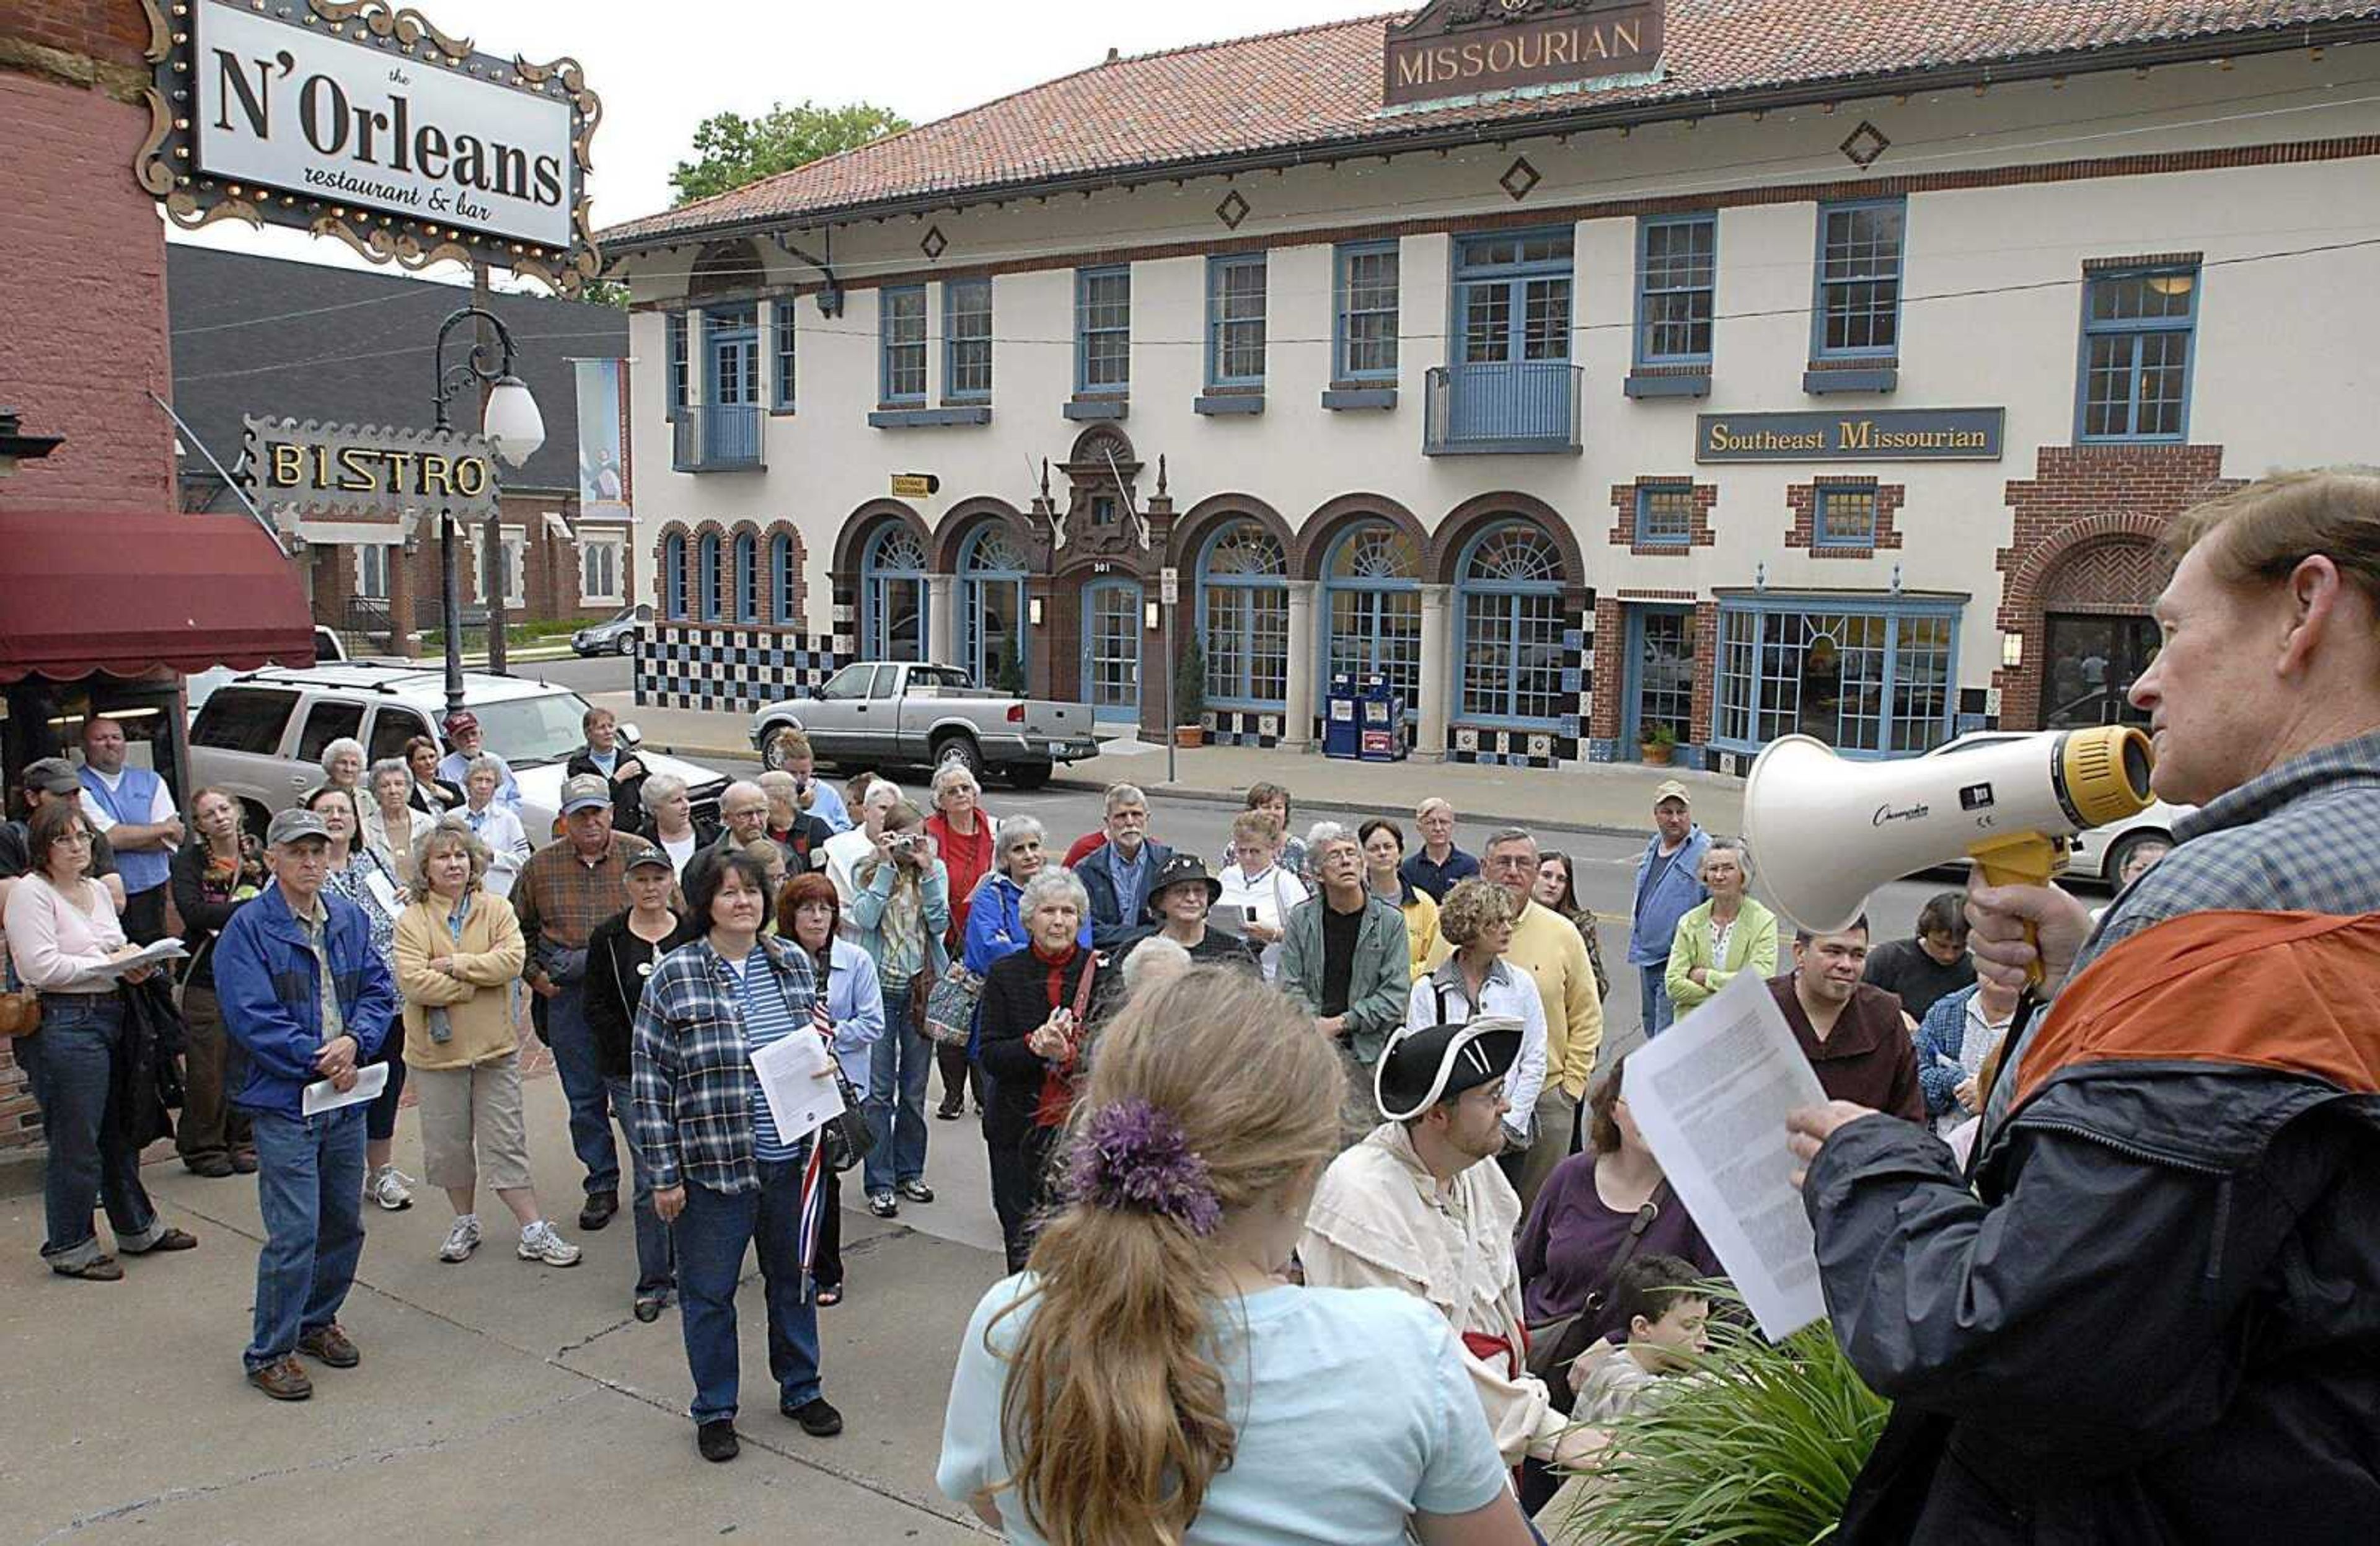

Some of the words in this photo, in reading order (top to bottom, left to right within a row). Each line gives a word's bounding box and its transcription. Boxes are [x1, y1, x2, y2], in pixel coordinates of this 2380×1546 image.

[389, 67, 410, 86] the
[1398, 18, 1641, 86] MISSOURIAN
[304, 166, 423, 206] restaurant
[427, 187, 452, 211] &
[457, 192, 491, 222] bar
[1710, 423, 1825, 451] Southeast
[1838, 420, 1985, 450] Missourian
[266, 441, 486, 496] BISTRO
